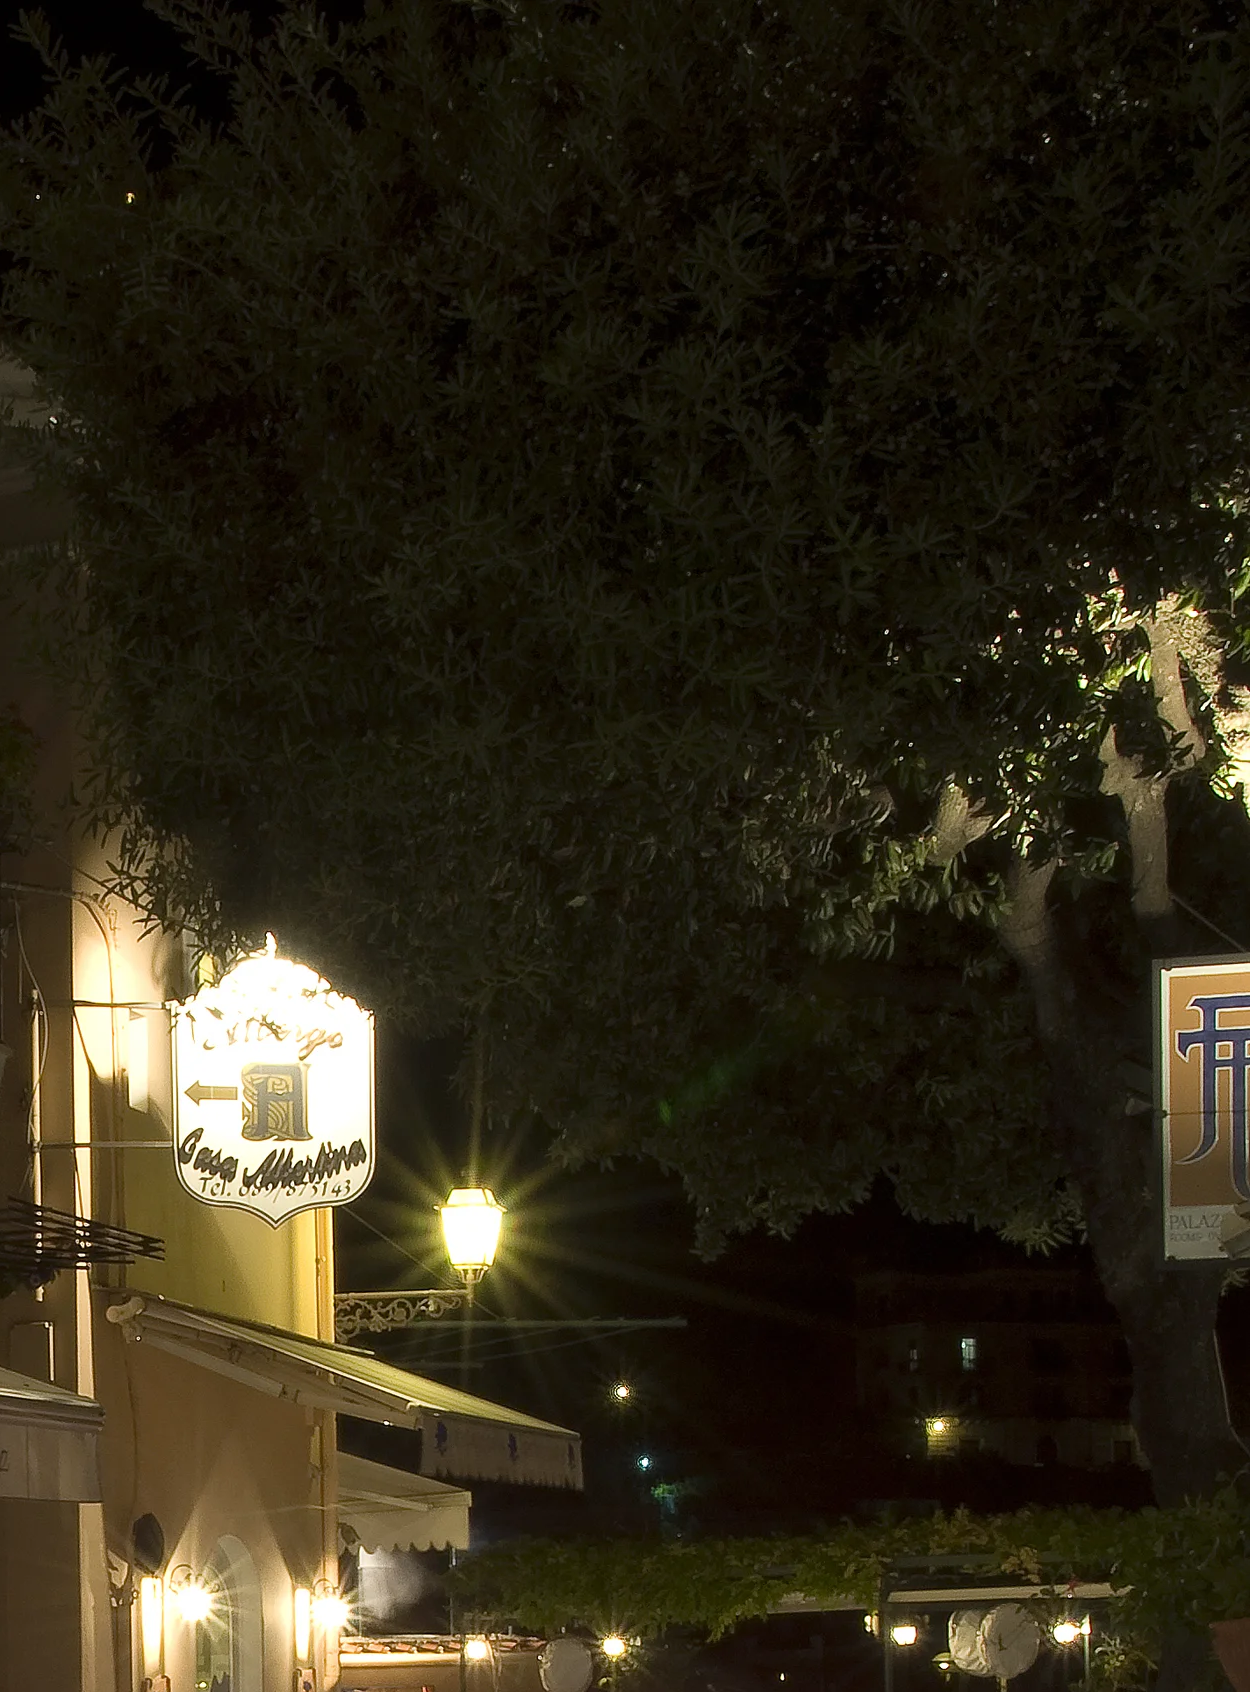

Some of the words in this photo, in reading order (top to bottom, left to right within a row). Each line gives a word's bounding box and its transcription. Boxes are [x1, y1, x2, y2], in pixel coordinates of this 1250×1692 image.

[179, 1128, 238, 1183] Casa
[243, 1139, 367, 1190] Albertina
[199, 1176, 231, 1197] Tel.
